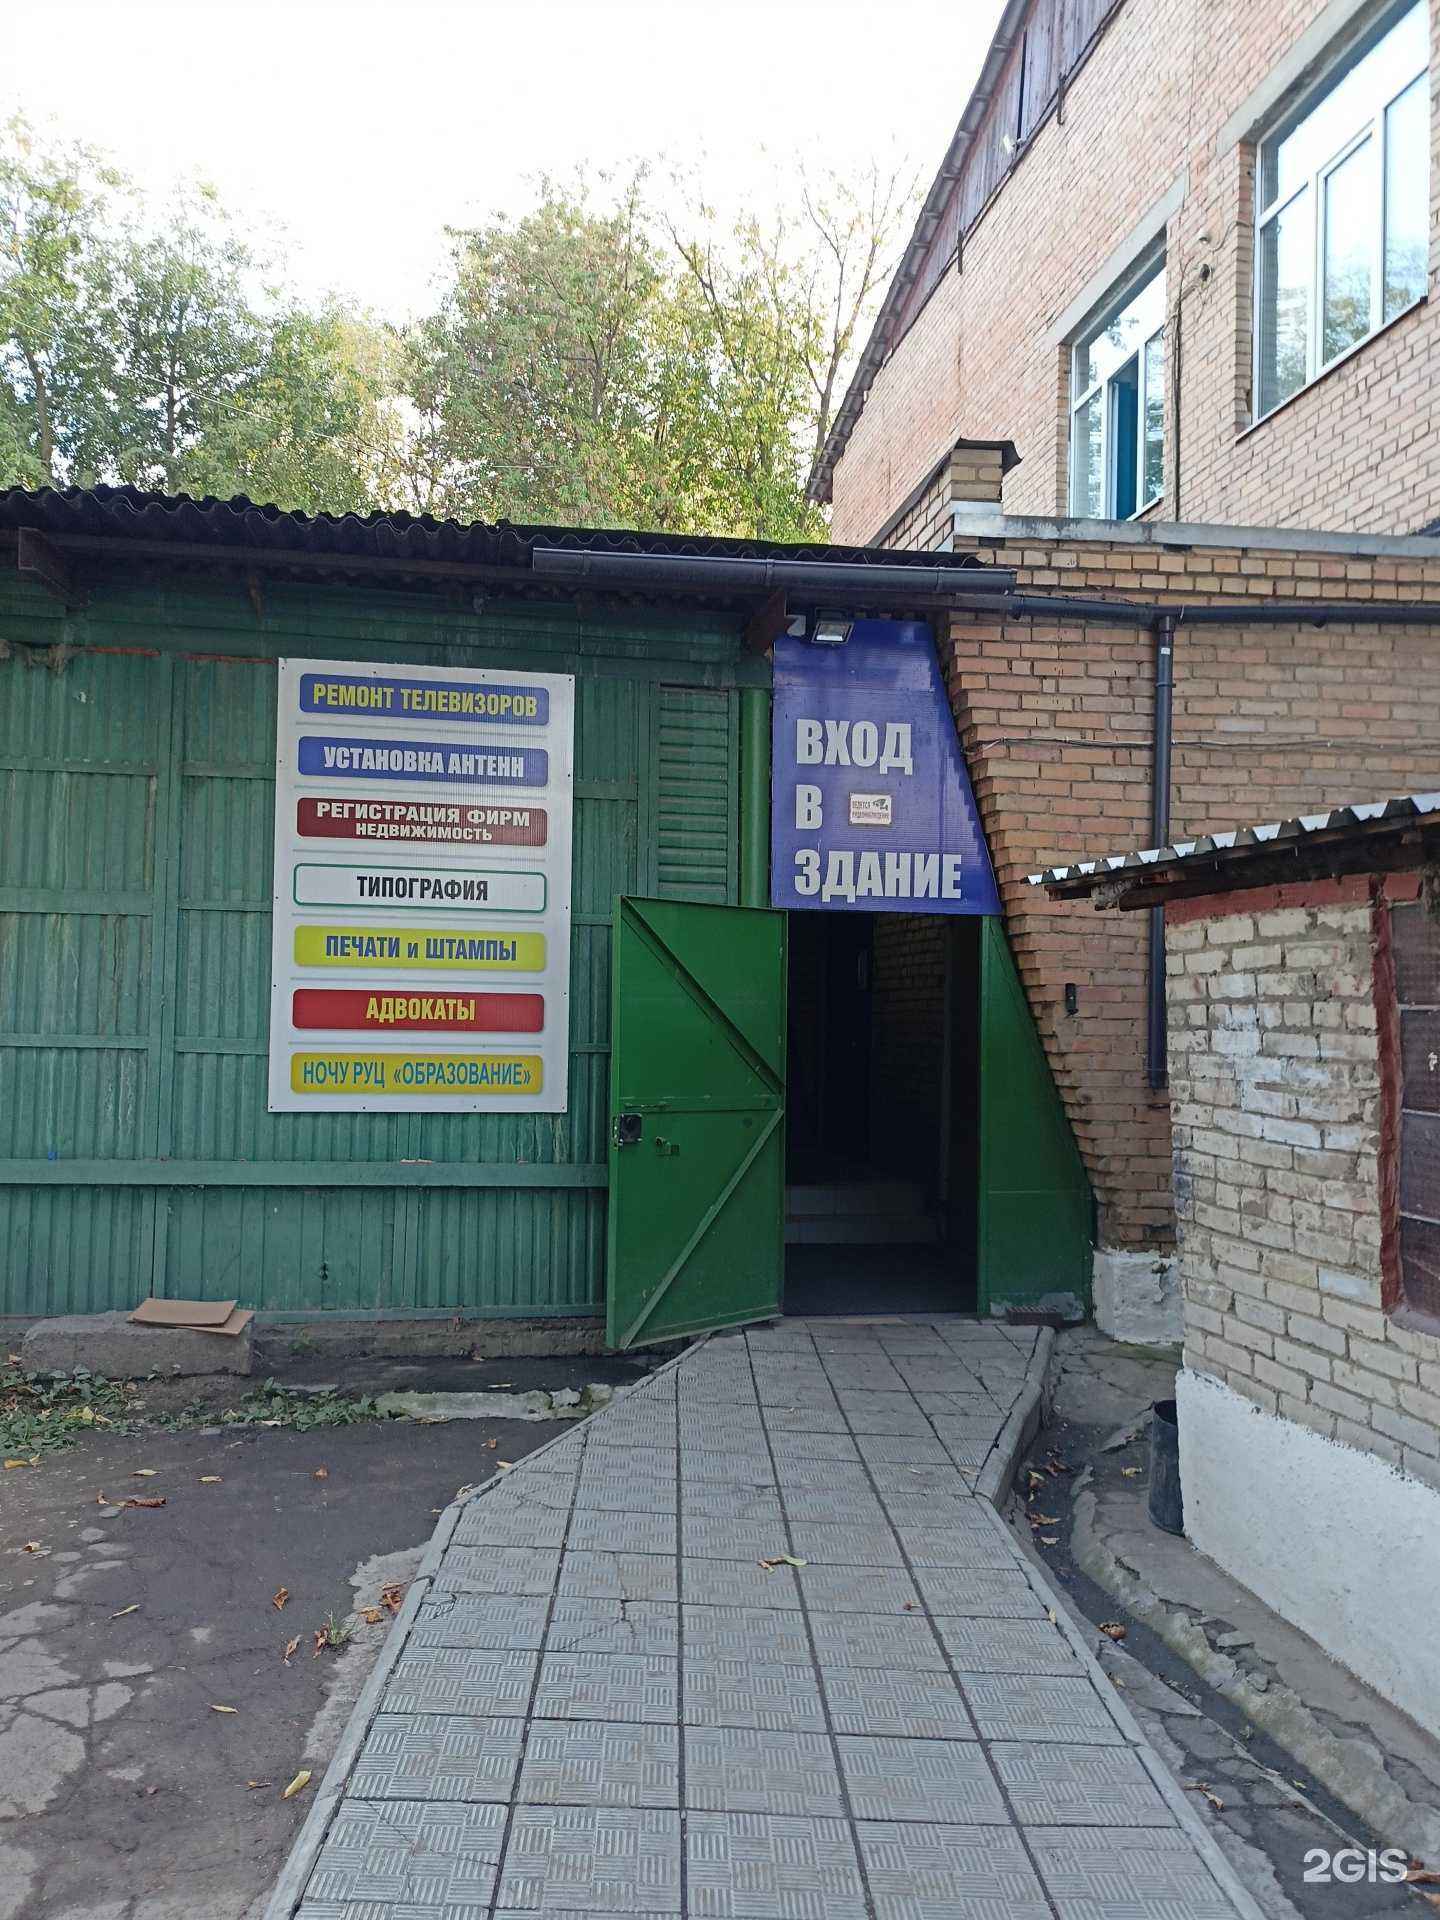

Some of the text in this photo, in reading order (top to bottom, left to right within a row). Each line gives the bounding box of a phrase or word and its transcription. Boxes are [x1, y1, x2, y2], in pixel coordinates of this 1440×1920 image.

[313, 683, 537, 717] РЕМОНТ ТЕЛЕВИЗОРОВ
[796, 719, 913, 775] ВХОД
[323, 746, 524, 777] УСТАНОВКА АНТЕНН
[317, 802, 530, 827] РЕГИСТРАЦИЯ ФИРМ
[796, 784, 823, 829] В
[355, 823, 493, 841] НЕДВИЖИМОСТЬ
[356, 876, 488, 901] ТИПОГРАФИЯ
[794, 849, 962, 903] ЗДАНИЕ
[326, 935, 517, 961] ПЕЧАТИ и ШТАМПЫ
[365, 997, 476, 1023] АДВОКАТЫ
[303, 1061, 532, 1088] НОЧУ РУЦ «ОБРАЗОВАНИЕ»
